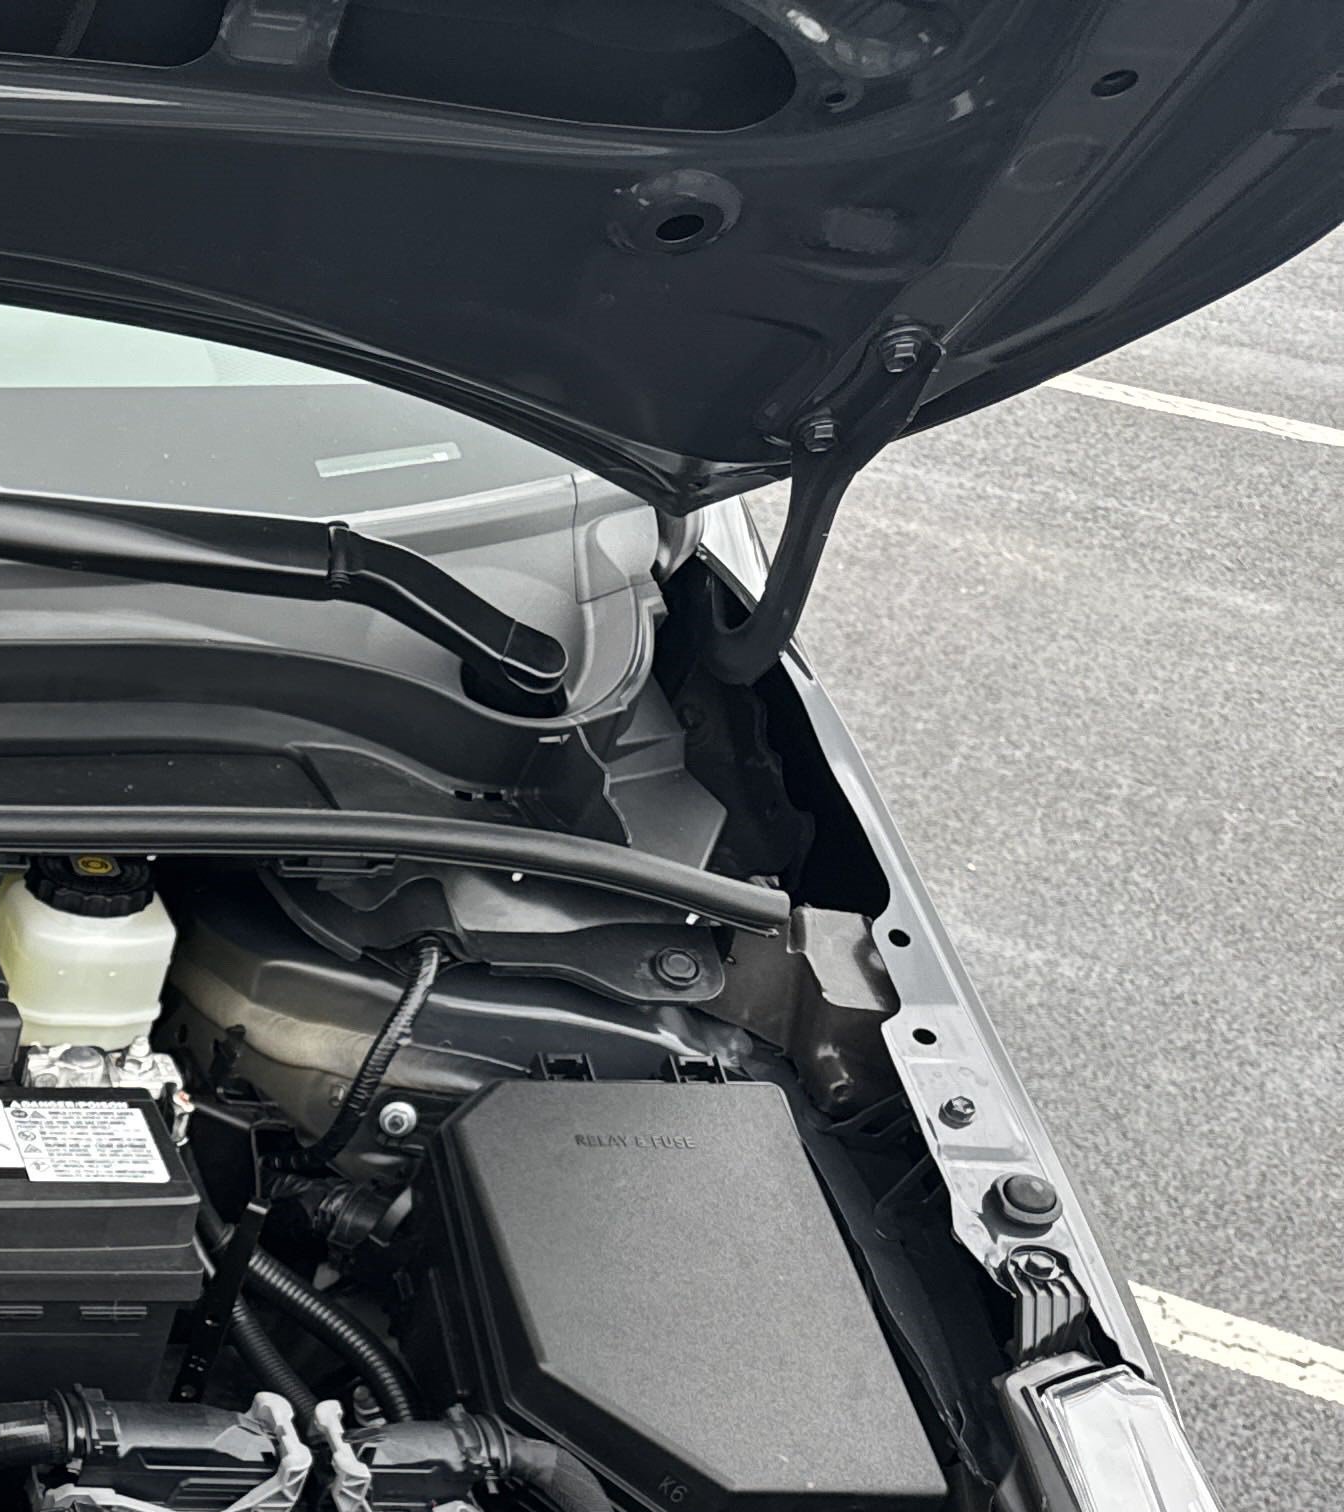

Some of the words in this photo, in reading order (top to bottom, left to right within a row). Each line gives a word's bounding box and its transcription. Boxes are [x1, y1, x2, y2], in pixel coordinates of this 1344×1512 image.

[574, 1133, 628, 1148] RELAY
[650, 1135, 697, 1150] FUSE
[657, 1475, 689, 1503] K6
